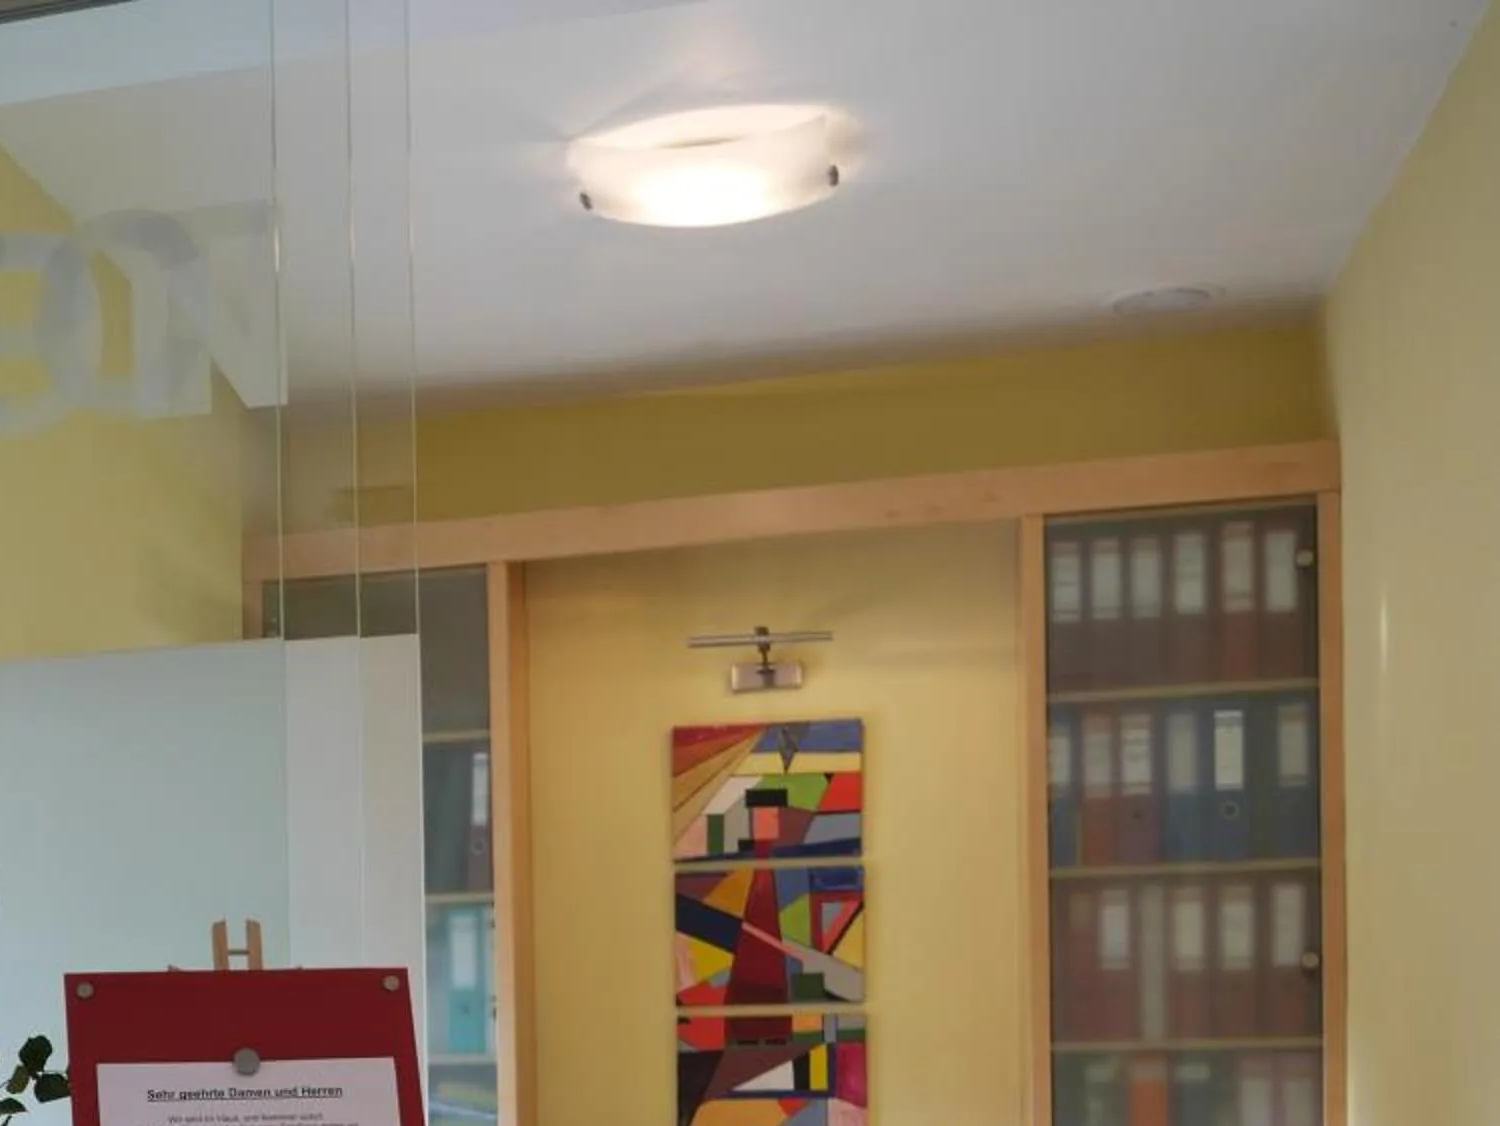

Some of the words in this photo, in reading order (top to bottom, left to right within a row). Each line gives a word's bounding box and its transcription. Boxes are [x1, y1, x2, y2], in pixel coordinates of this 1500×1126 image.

[147, 1088, 175, 1101] Sehr
[178, 1087, 226, 1101] geehrte
[228, 1086, 271, 1100] Damen
[274, 1086, 299, 1099] und
[301, 1084, 343, 1098] Herren
